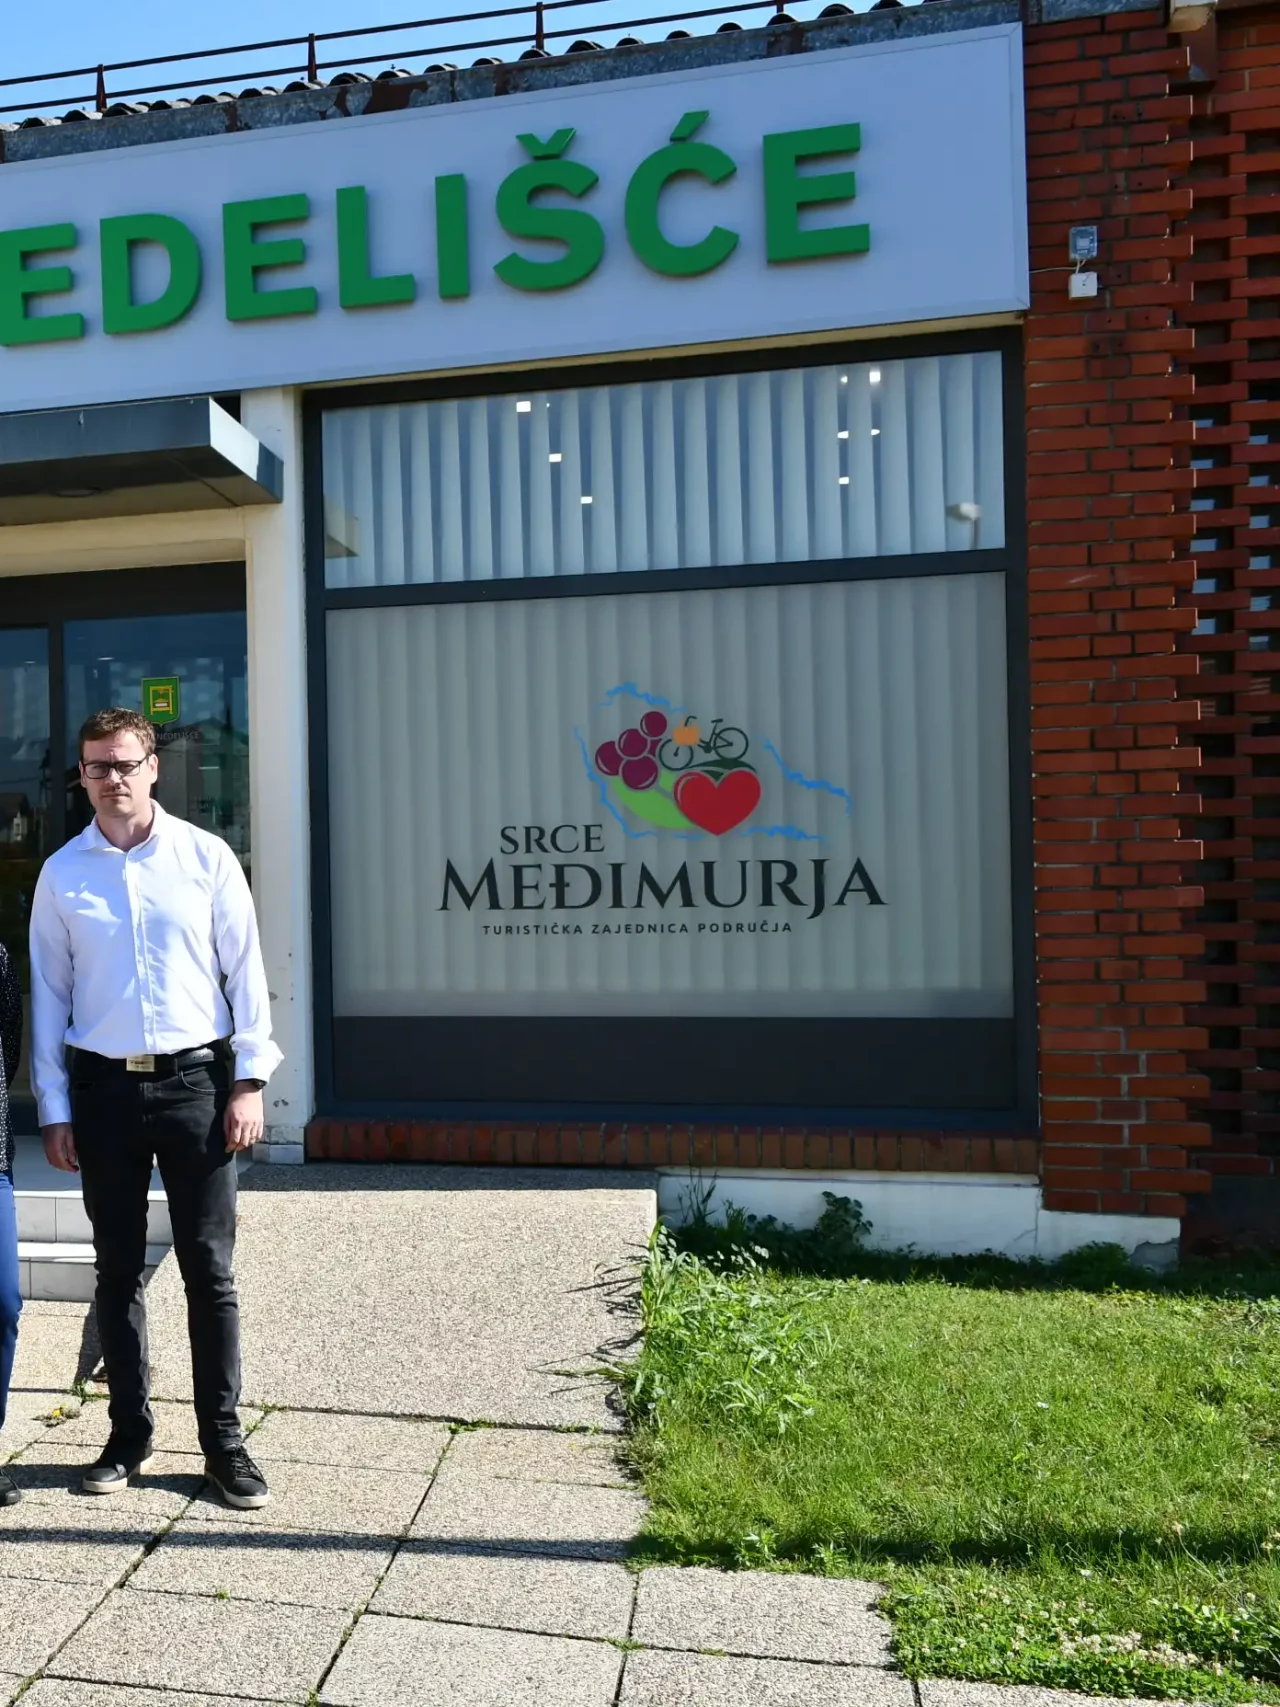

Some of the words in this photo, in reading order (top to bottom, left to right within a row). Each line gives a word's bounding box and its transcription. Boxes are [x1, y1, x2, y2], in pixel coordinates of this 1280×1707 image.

[499, 824, 606, 855] SRCE
[436, 856, 889, 920] MEĐIMURJA
[482, 922, 583, 936] TURISTIČKA
[591, 922, 689, 935] ZAJEDNICA
[697, 920, 793, 934] PODRUČJA
